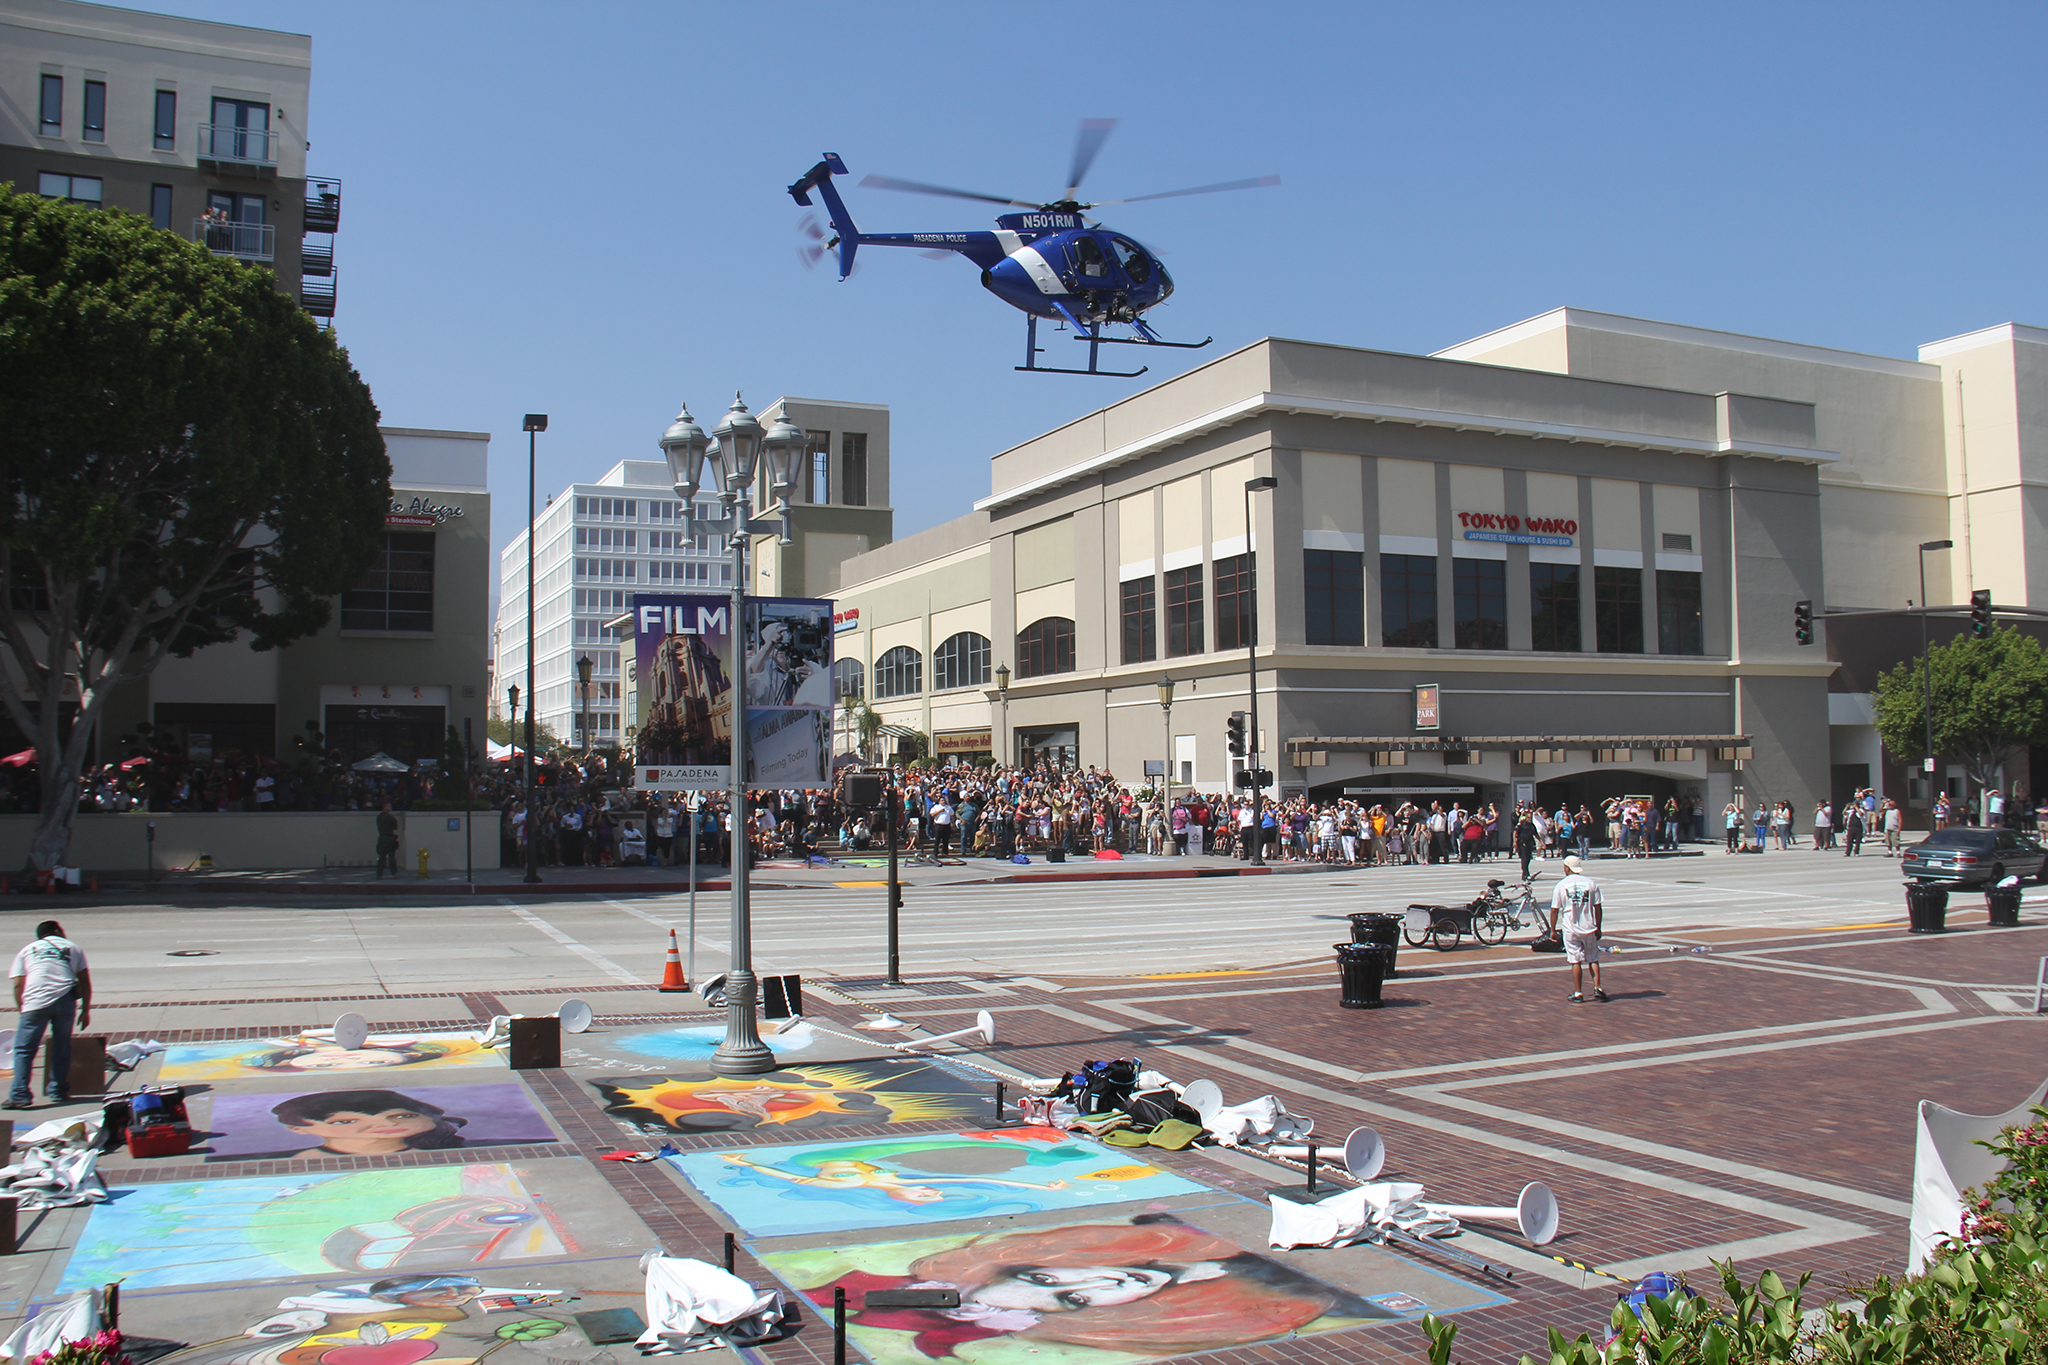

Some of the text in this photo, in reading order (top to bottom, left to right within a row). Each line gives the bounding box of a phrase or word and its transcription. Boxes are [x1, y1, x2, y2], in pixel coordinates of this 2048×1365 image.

[1022, 215, 1074, 228] N501RM
[914, 234, 968, 242] PASADENA POLICE
[408, 496, 464, 523] Alegre
[391, 516, 432, 524] Steakhouse
[1458, 512, 1578, 536] TOKYO WAKO
[1469, 532, 1498, 541] JAPANESE
[640, 606, 726, 635] FILM
[1417, 709, 1435, 718] PARK
[761, 718, 780, 740] ALMA
[939, 737, 959, 748] Pasadena
[960, 736, 979, 749] Antique
[1388, 742, 1471, 751] ENTRANCE
[1652, 740, 1686, 748] ONLY
[761, 758, 786, 776] Filming
[788, 747, 809, 764] Today
[660, 769, 718, 777] PASADENA
